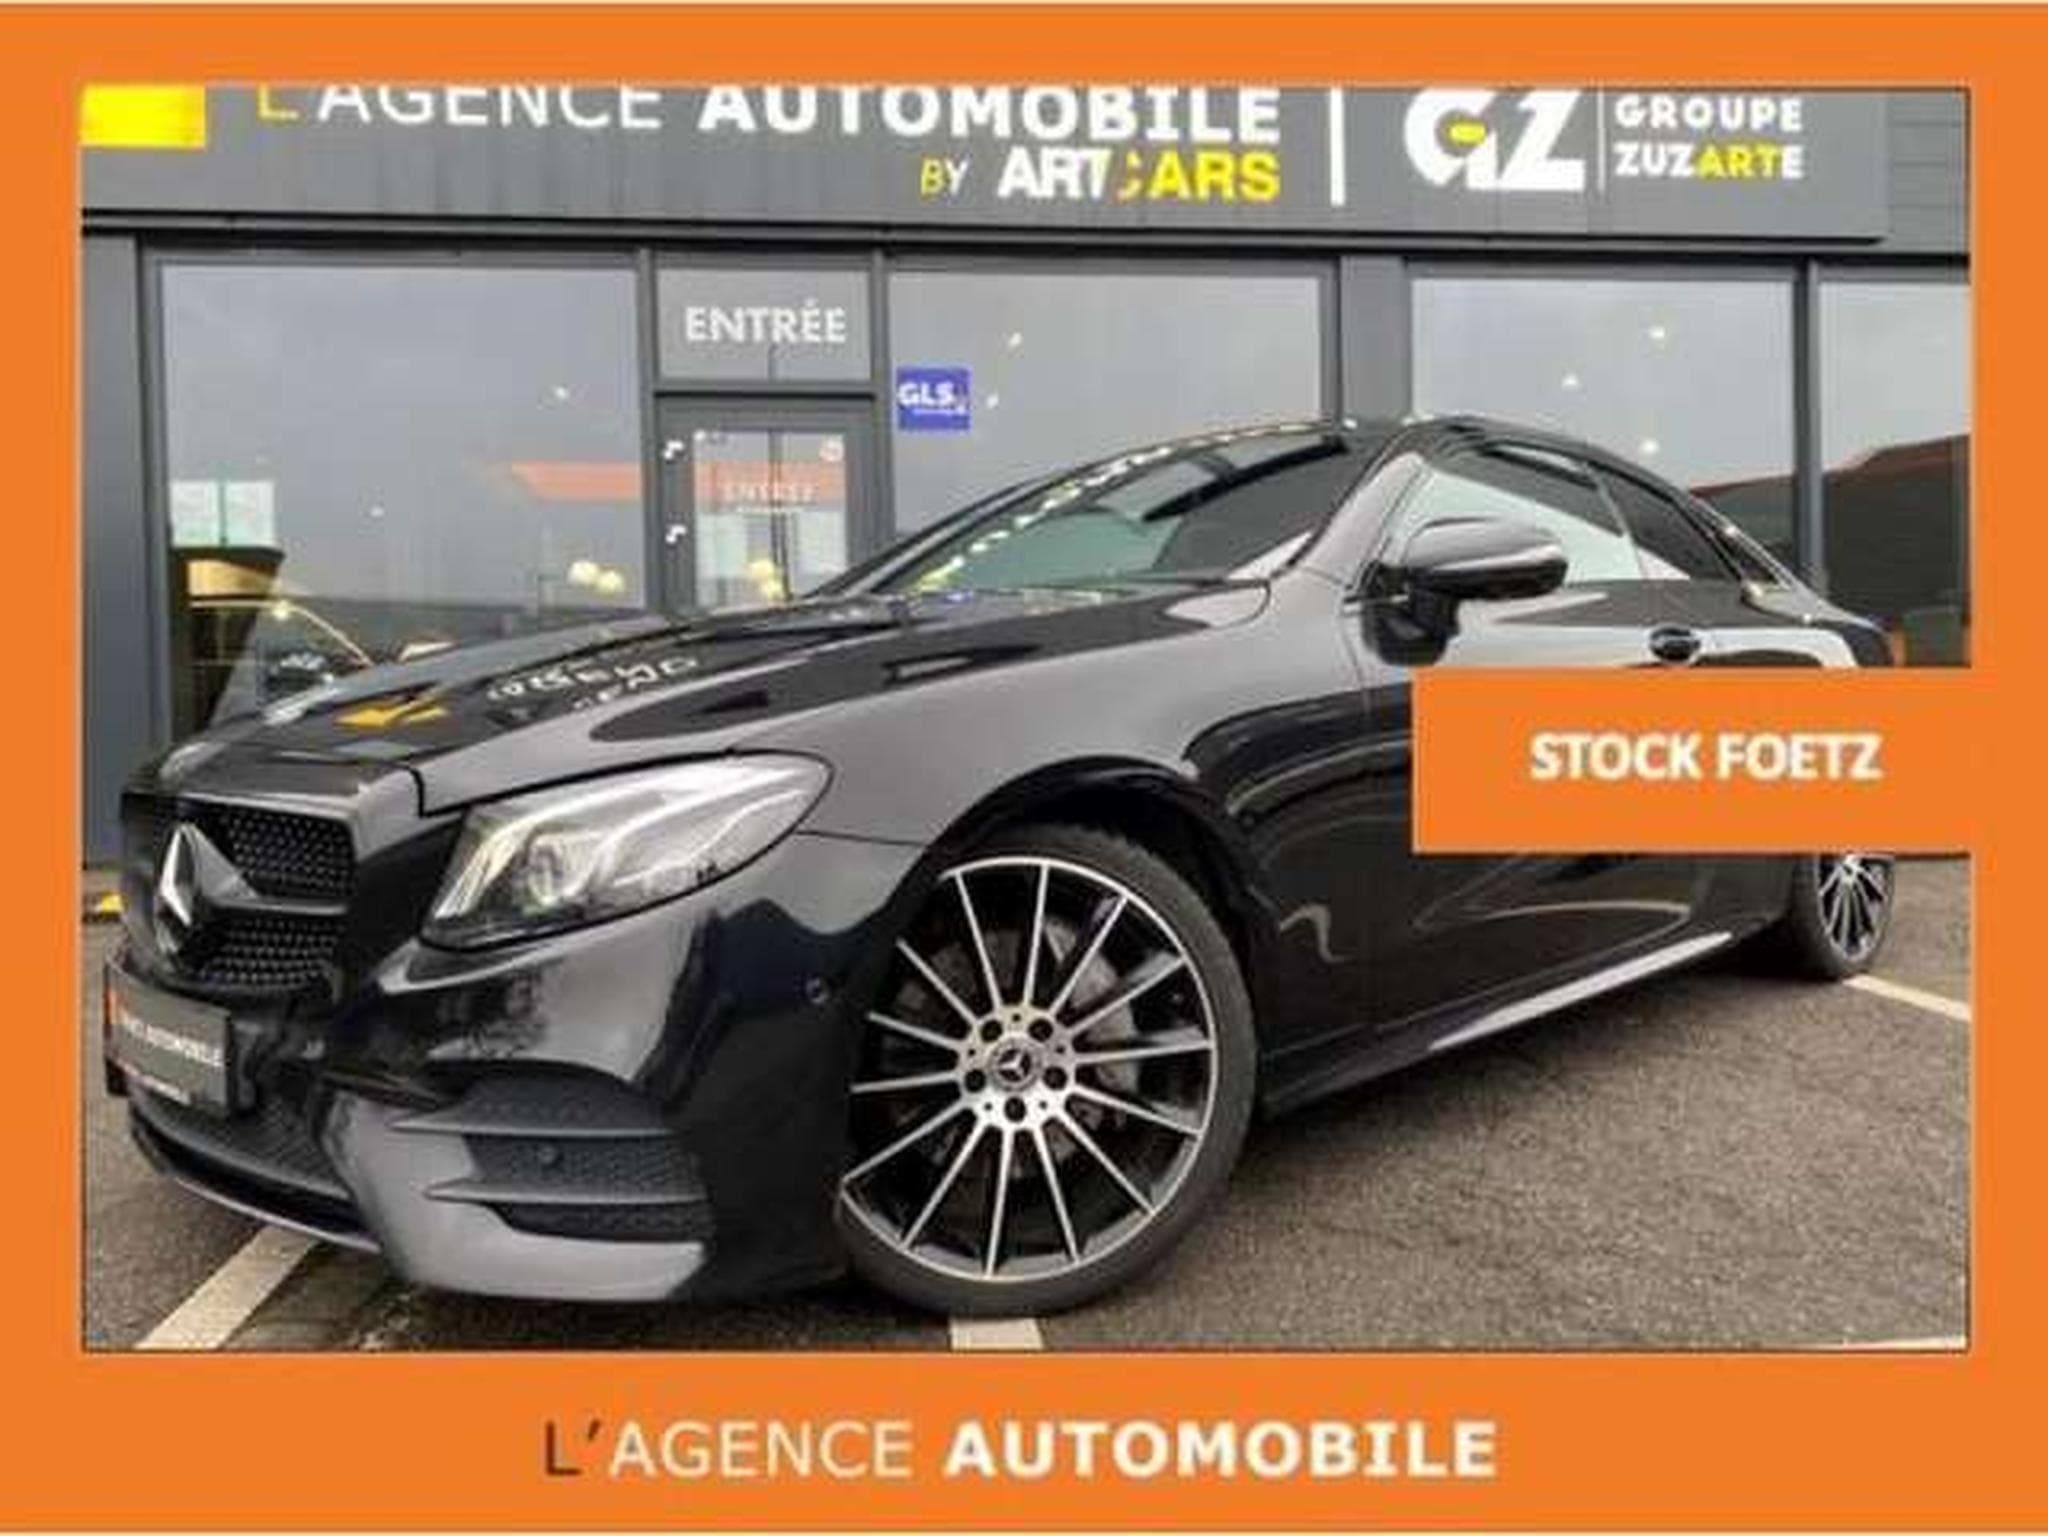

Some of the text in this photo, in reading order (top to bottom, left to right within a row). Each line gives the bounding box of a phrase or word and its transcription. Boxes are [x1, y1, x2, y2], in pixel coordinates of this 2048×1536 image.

[698, 85, 1281, 143] AUTOMOBILE
[1614, 94, 1803, 132] GROUPE
[920, 157, 968, 196] BY
[1614, 141, 1804, 179] ZUZARTE
[684, 298, 847, 344] ENTRÉE
[898, 381, 956, 406] GLS
